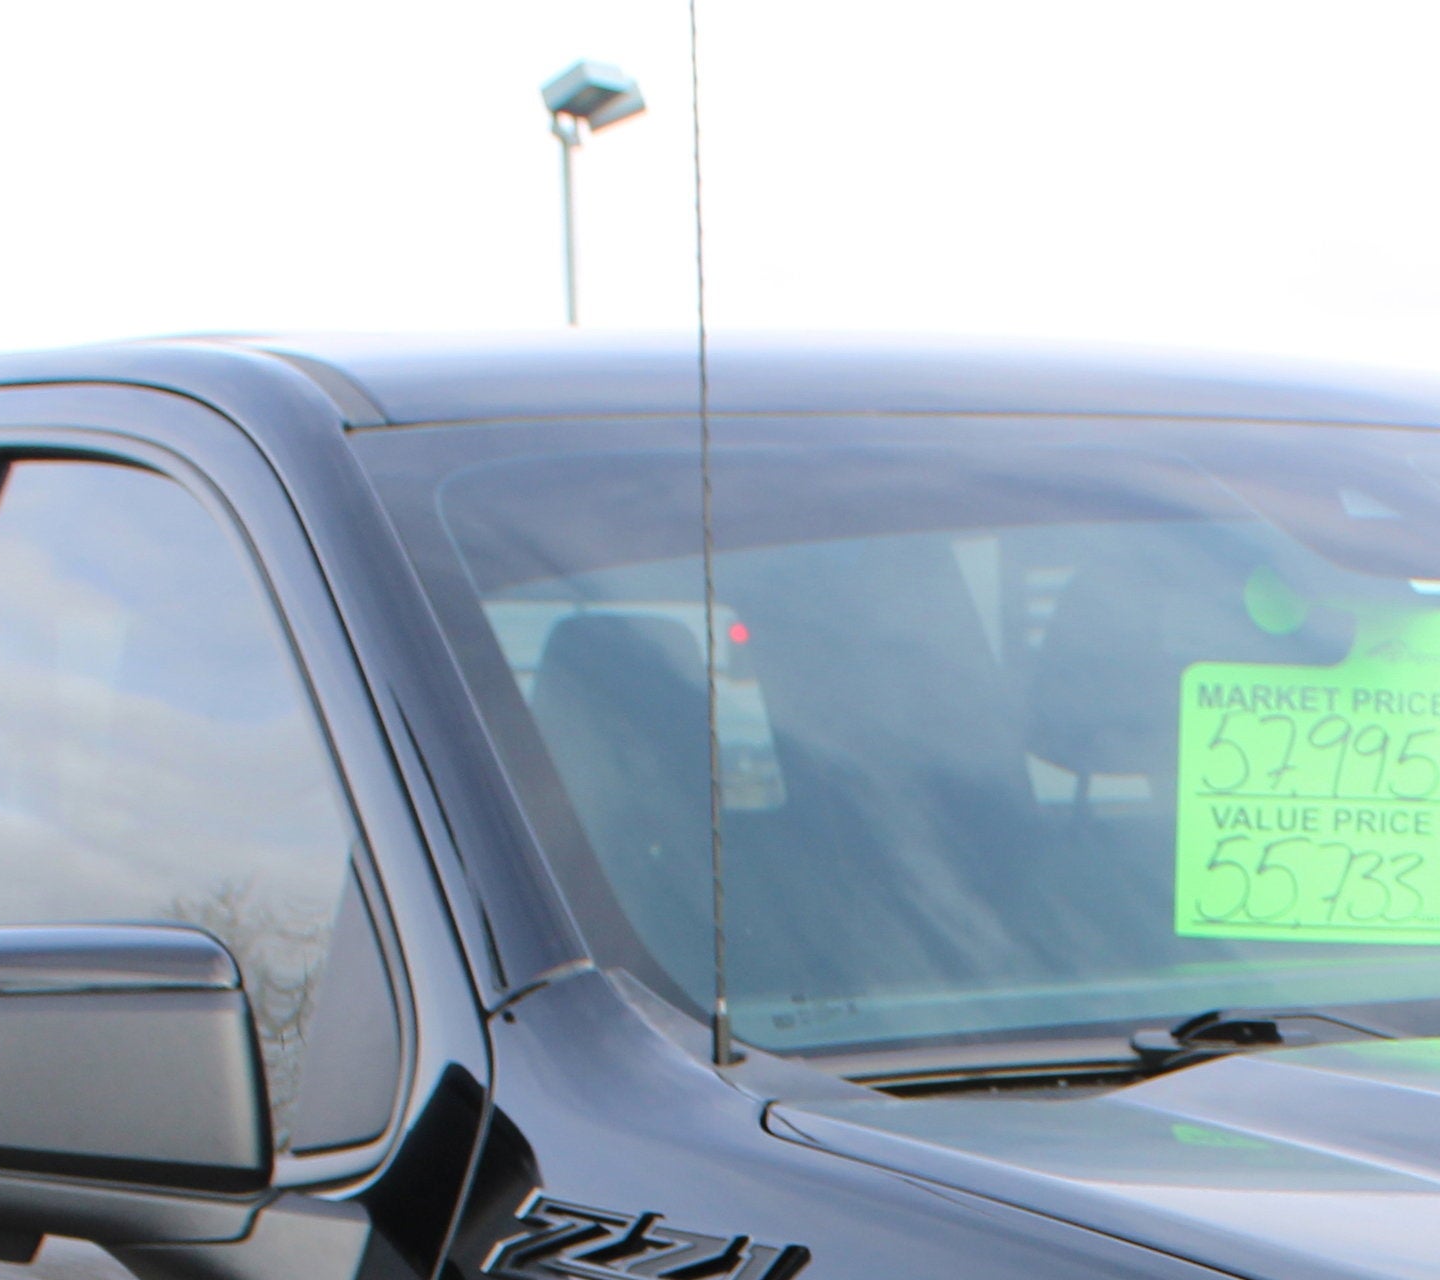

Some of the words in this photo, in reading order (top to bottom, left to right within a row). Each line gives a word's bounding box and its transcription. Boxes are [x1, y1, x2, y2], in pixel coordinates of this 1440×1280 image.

[1197, 683, 1339, 712] MARKET
[1212, 806, 1321, 832] VALUE
[1333, 809, 1432, 835] PRICE
